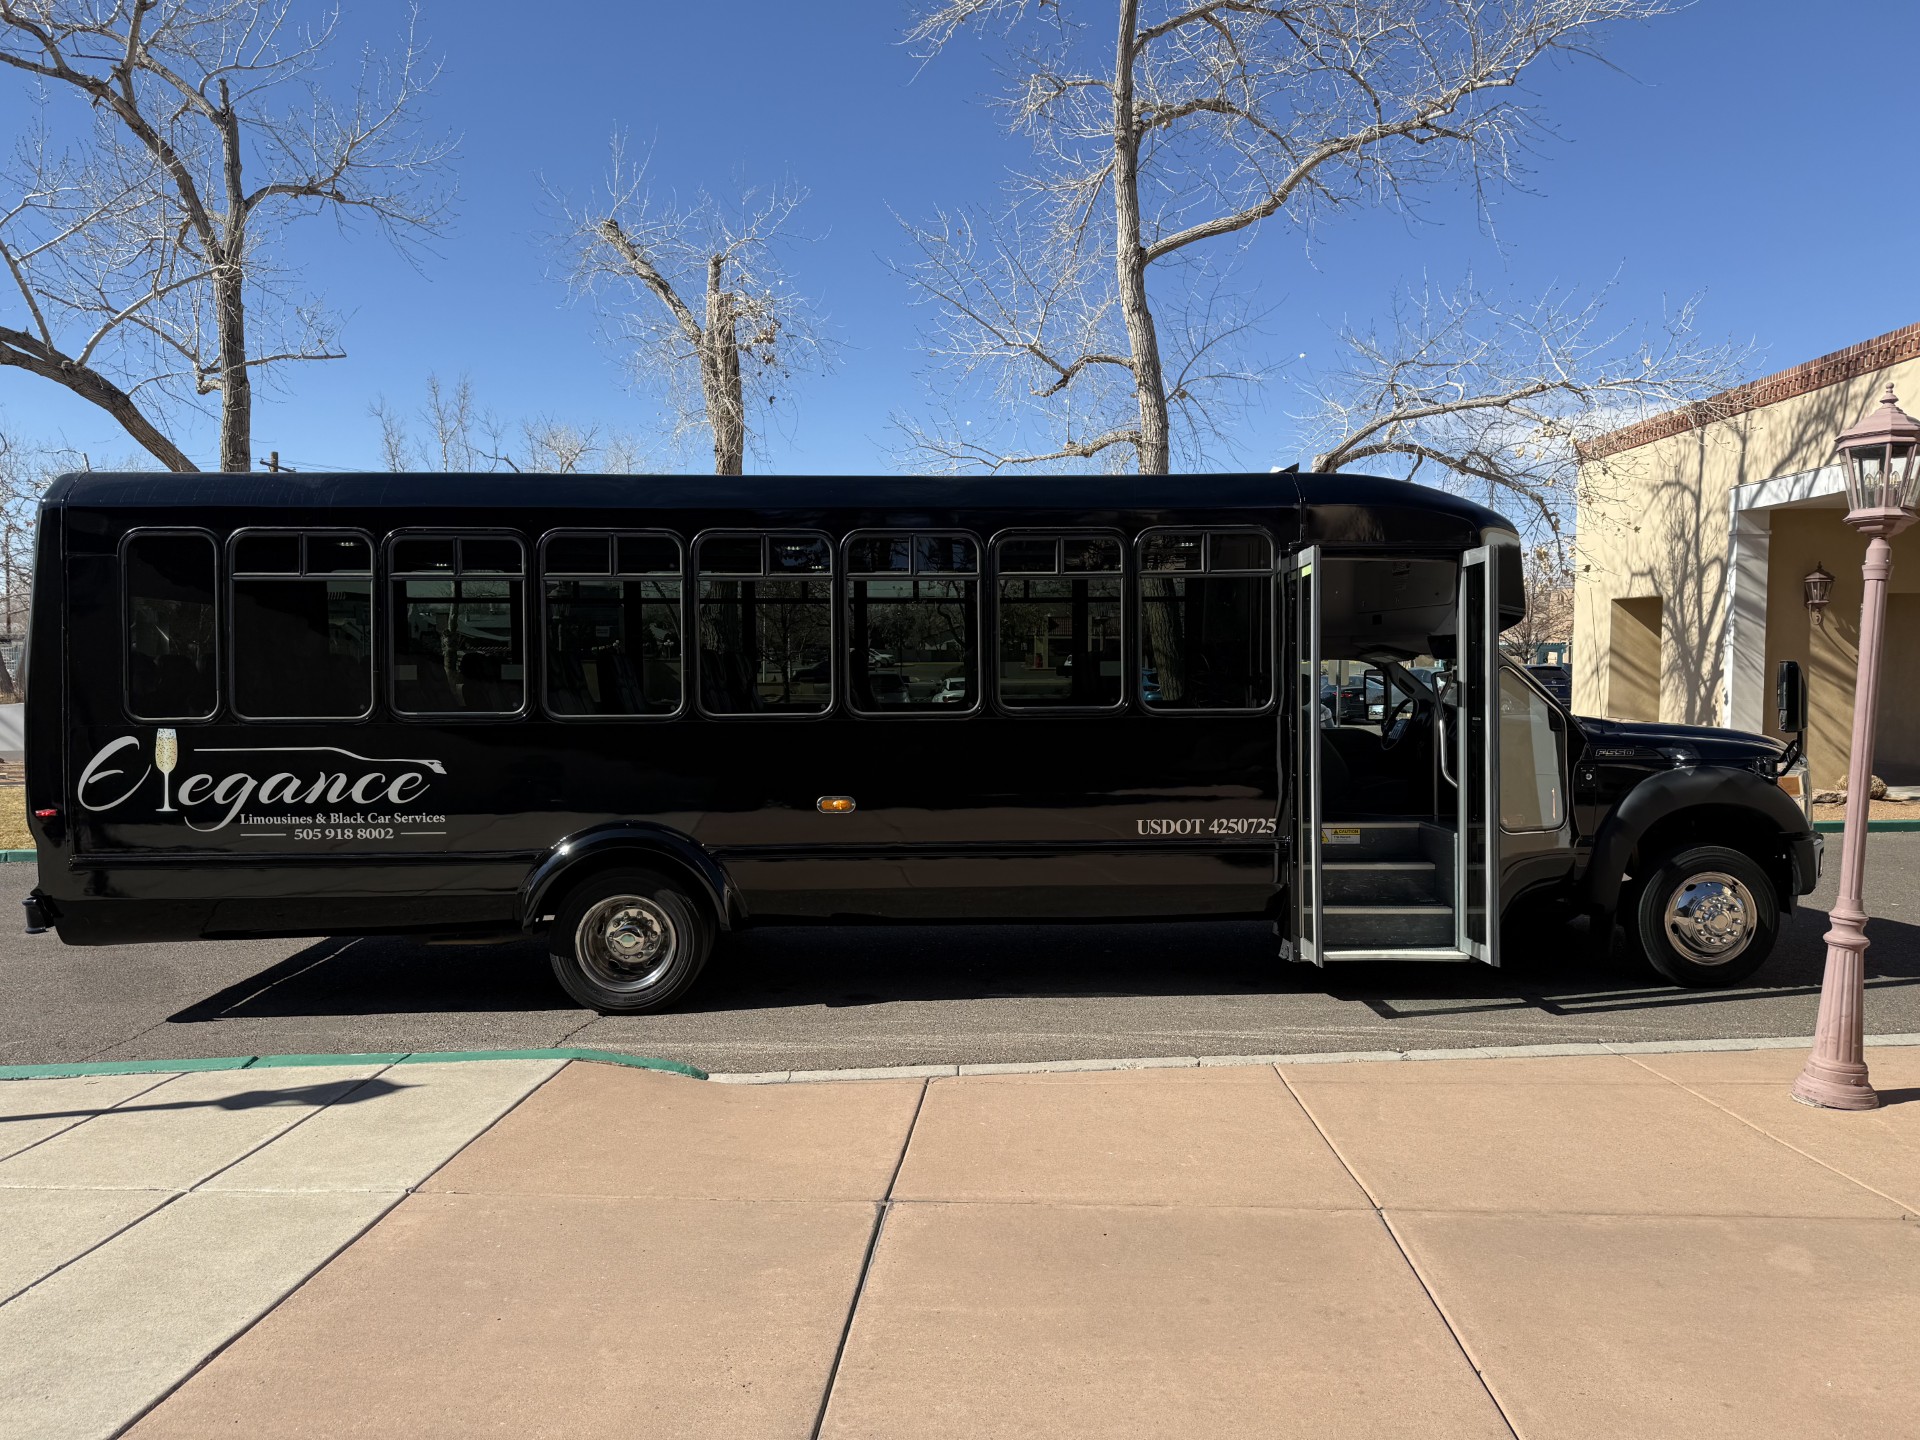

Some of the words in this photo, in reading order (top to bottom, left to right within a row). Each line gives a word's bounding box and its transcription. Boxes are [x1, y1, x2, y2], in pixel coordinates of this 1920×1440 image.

[77, 728, 431, 832] Elegance
[240, 813, 313, 825] Limousines
[315, 812, 327, 824] &
[329, 812, 366, 824] Black
[367, 812, 392, 824] Car
[393, 811, 446, 824] Services
[294, 828, 322, 840] 505
[325, 828, 354, 840] 918
[356, 827, 395, 840] 8002
[1136, 818, 1205, 835] USDOT
[1208, 818, 1277, 834] 4250725
